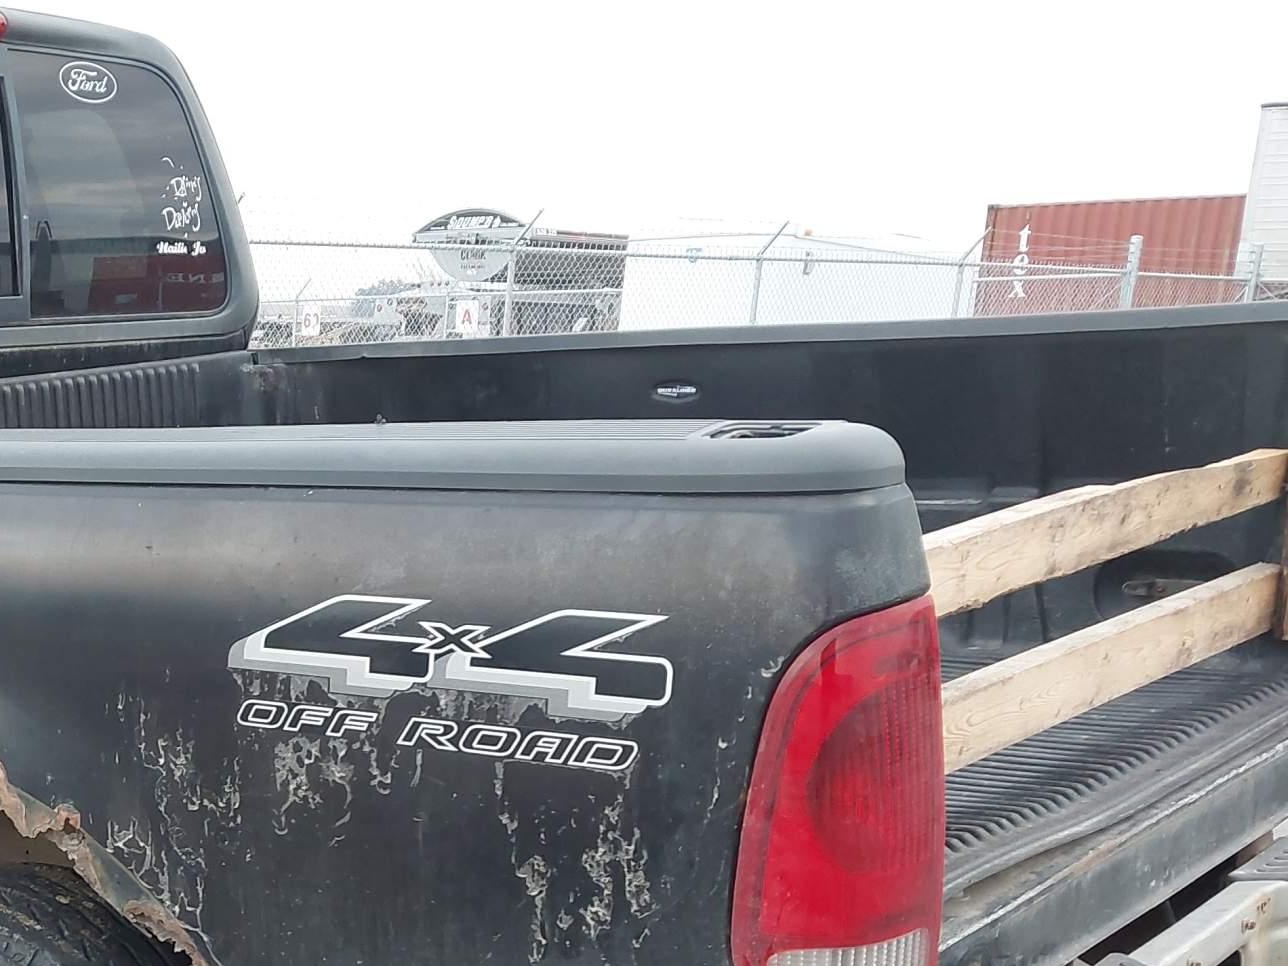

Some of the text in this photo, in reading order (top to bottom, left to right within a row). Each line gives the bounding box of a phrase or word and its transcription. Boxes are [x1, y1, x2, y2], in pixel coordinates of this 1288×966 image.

[68, 69, 108, 93] Ford
[236, 699, 639, 771] OFF ROAD
